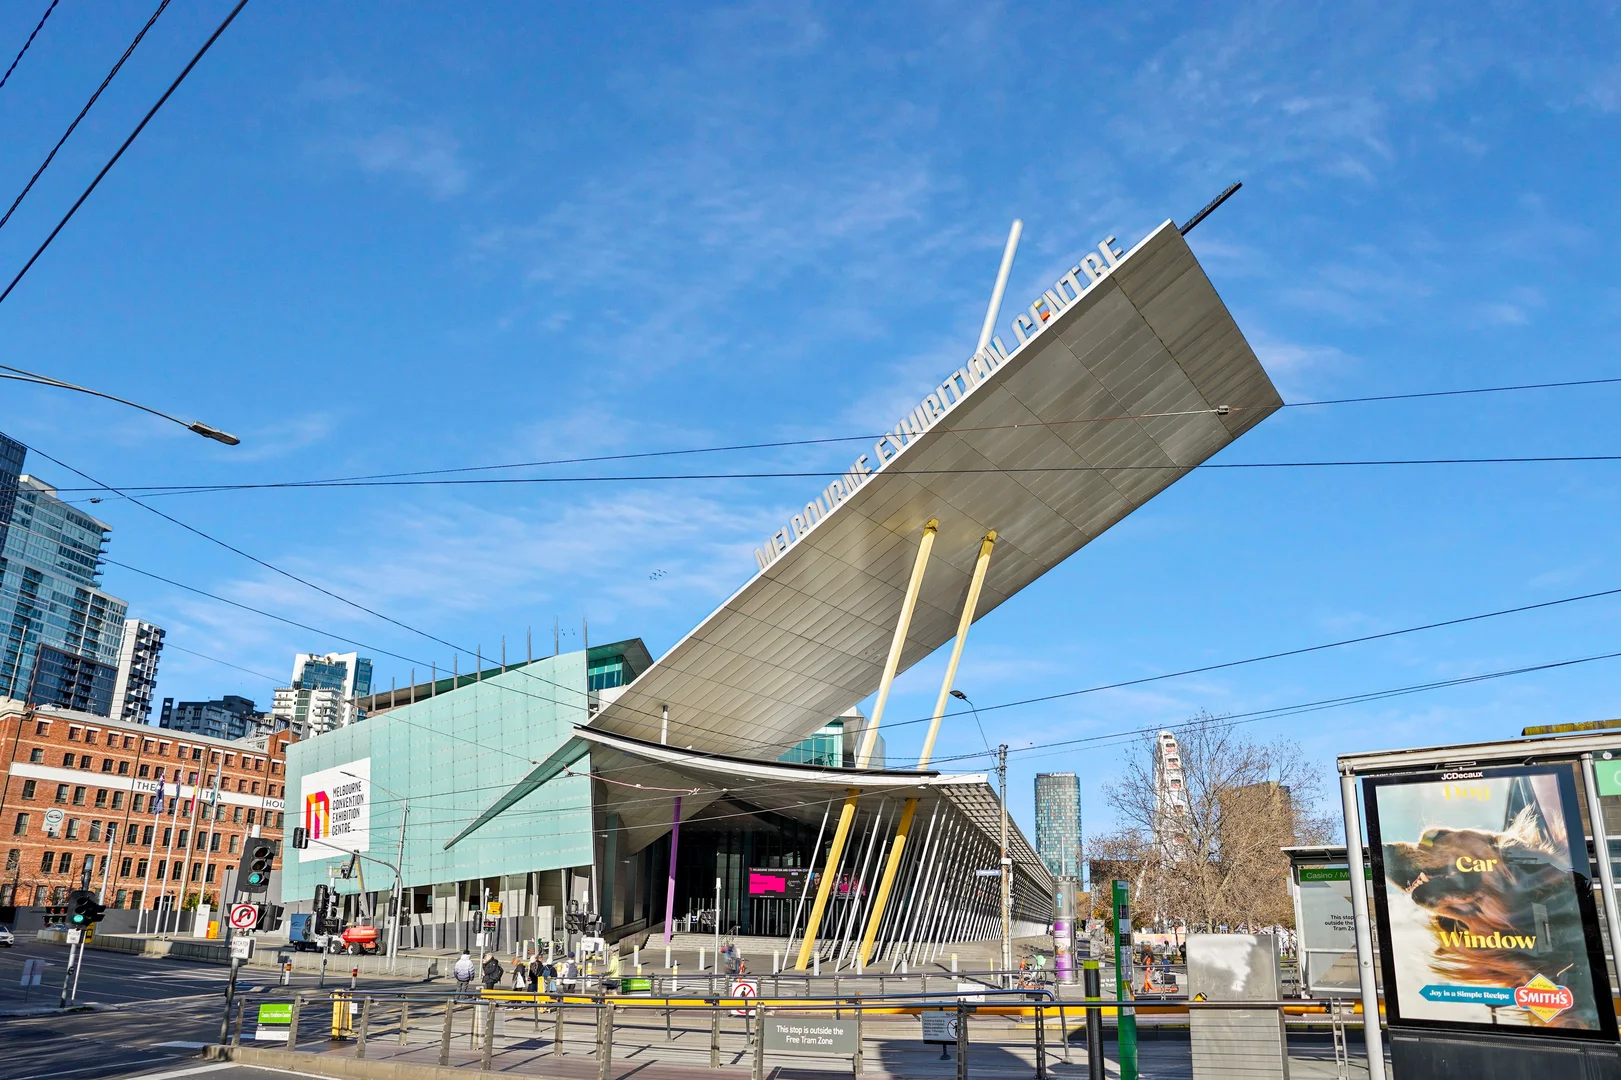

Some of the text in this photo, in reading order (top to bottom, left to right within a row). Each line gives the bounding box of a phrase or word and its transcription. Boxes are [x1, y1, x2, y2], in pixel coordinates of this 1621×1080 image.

[754, 234, 1123, 571] MELBOURNE EXHIBITION CENTRE
[1441, 771, 1483, 780] JCDecaux
[136, 781, 156, 792] THE
[332, 781, 362, 798] MELBOURNE
[1444, 785, 1490, 801] Dog
[332, 794, 364, 810] CONVENTION
[332, 808, 360, 823] EXHIBITION
[332, 822, 351, 836] CENTRE
[1456, 856, 1498, 872] Car
[1439, 931, 1536, 950] Window
[1456, 991, 1482, 999] Simple
[1484, 992, 1510, 1000] Recipe
[1519, 990, 1568, 1005] SMITH'S
[776, 1025, 789, 1033] This
[790, 1026, 802, 1034] stop
[810, 1026, 832, 1035] outside
[833, 1027, 844, 1035] the
[786, 1035, 833, 1045] Free Tram Zone
